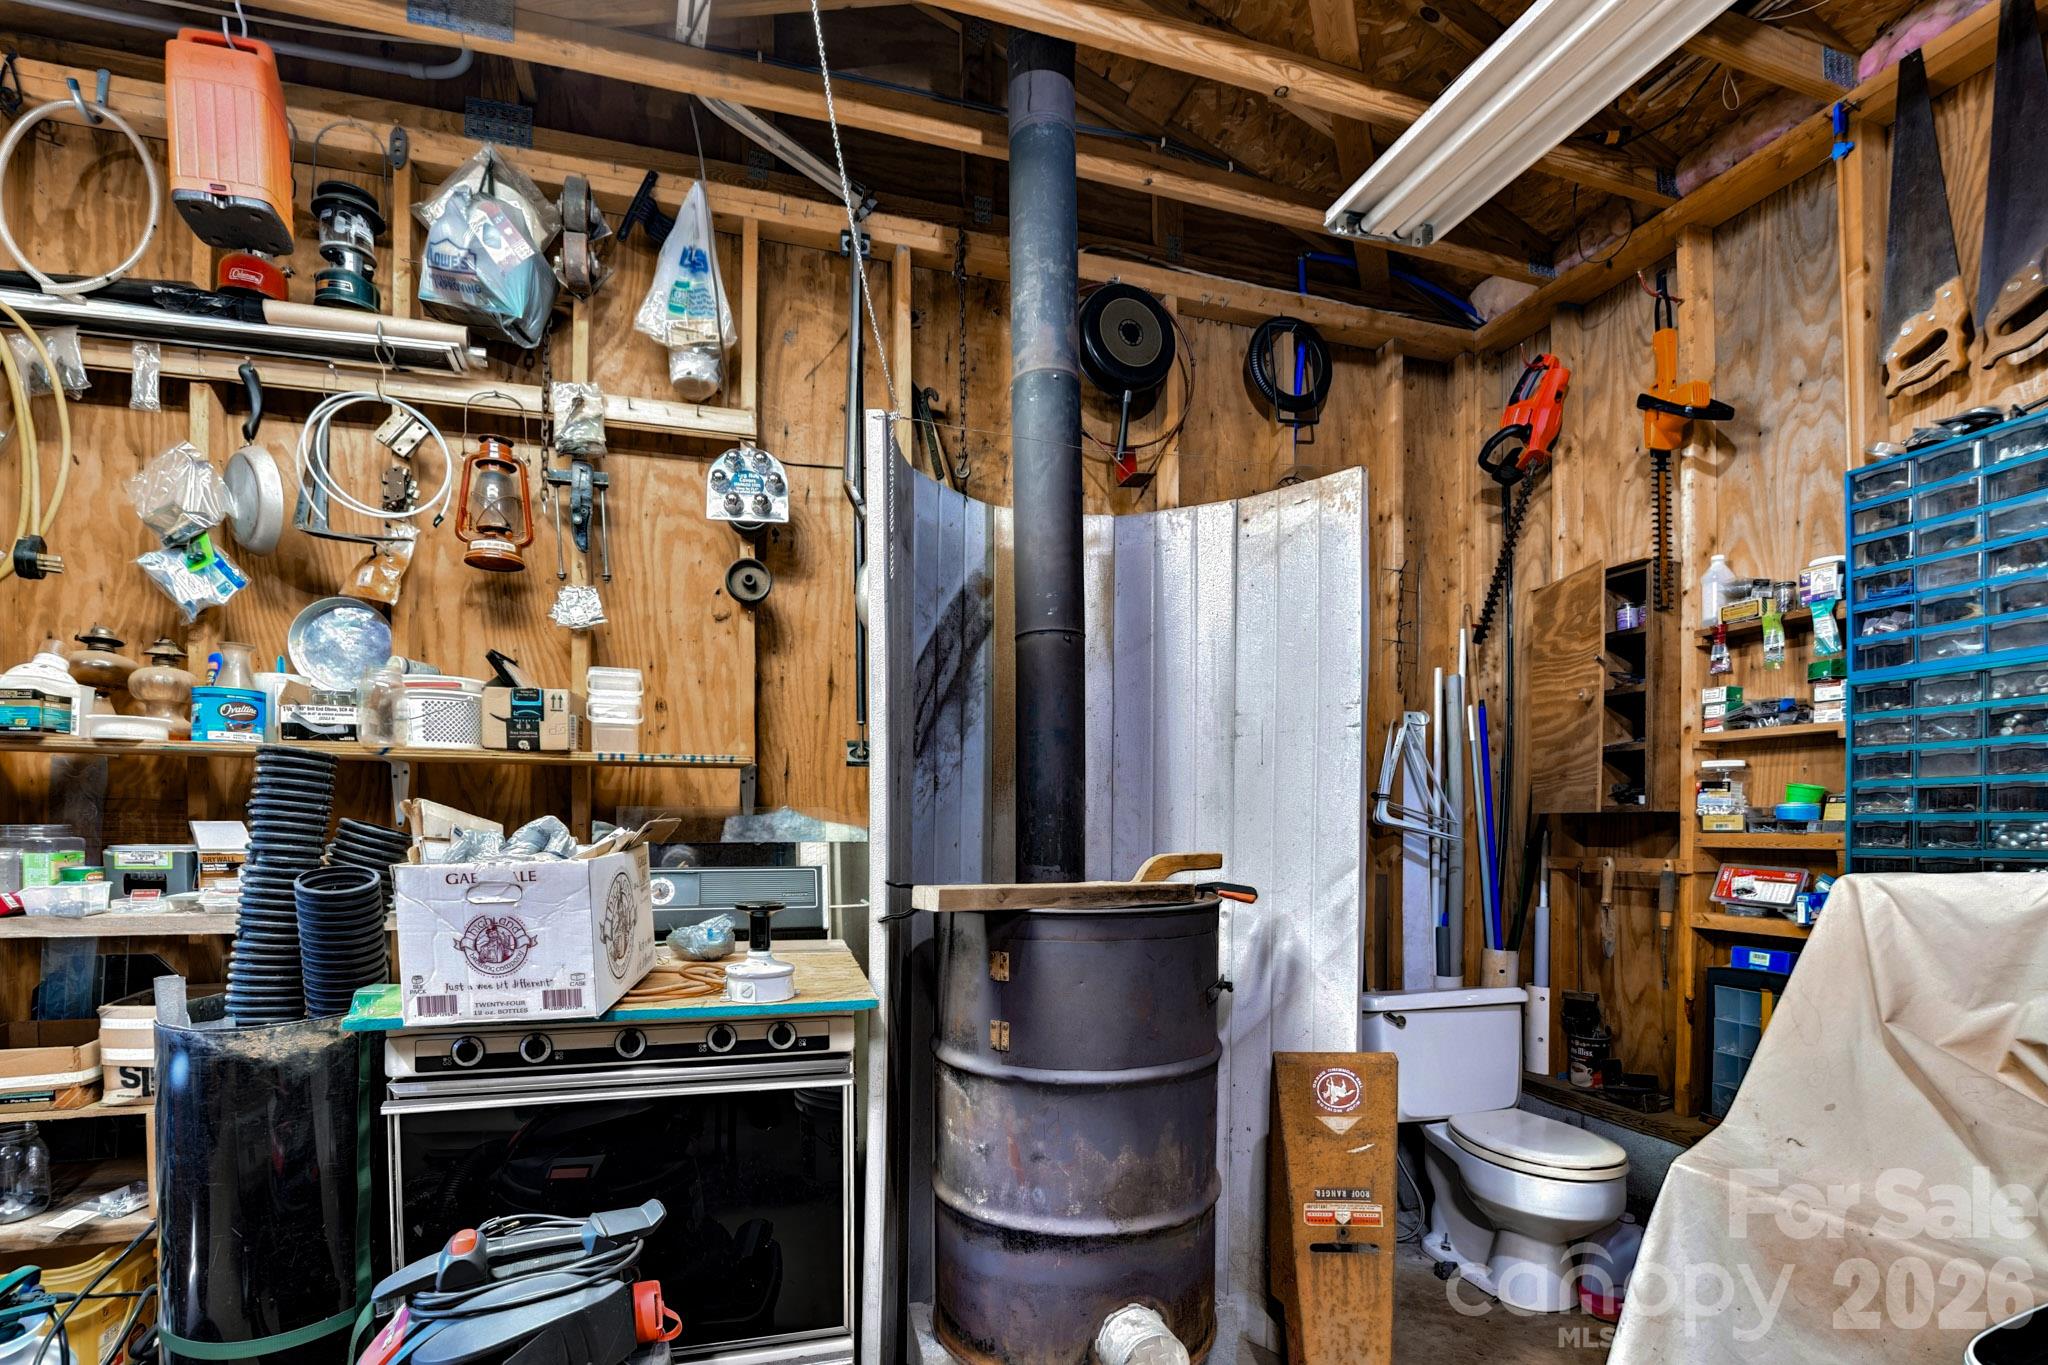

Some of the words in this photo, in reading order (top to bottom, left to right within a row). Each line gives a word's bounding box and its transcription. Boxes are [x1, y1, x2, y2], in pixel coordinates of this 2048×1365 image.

[231, 268, 261, 284] Coleman
[220, 703, 257, 716] Ovaltine
[444, 982, 464, 994] Just
[496, 980, 508, 990] bit
[474, 1000, 526, 1008] TWENTY-FOUR
[1314, 1189, 1347, 1197] RANGER
[1351, 1190, 1370, 1198] ROOF
